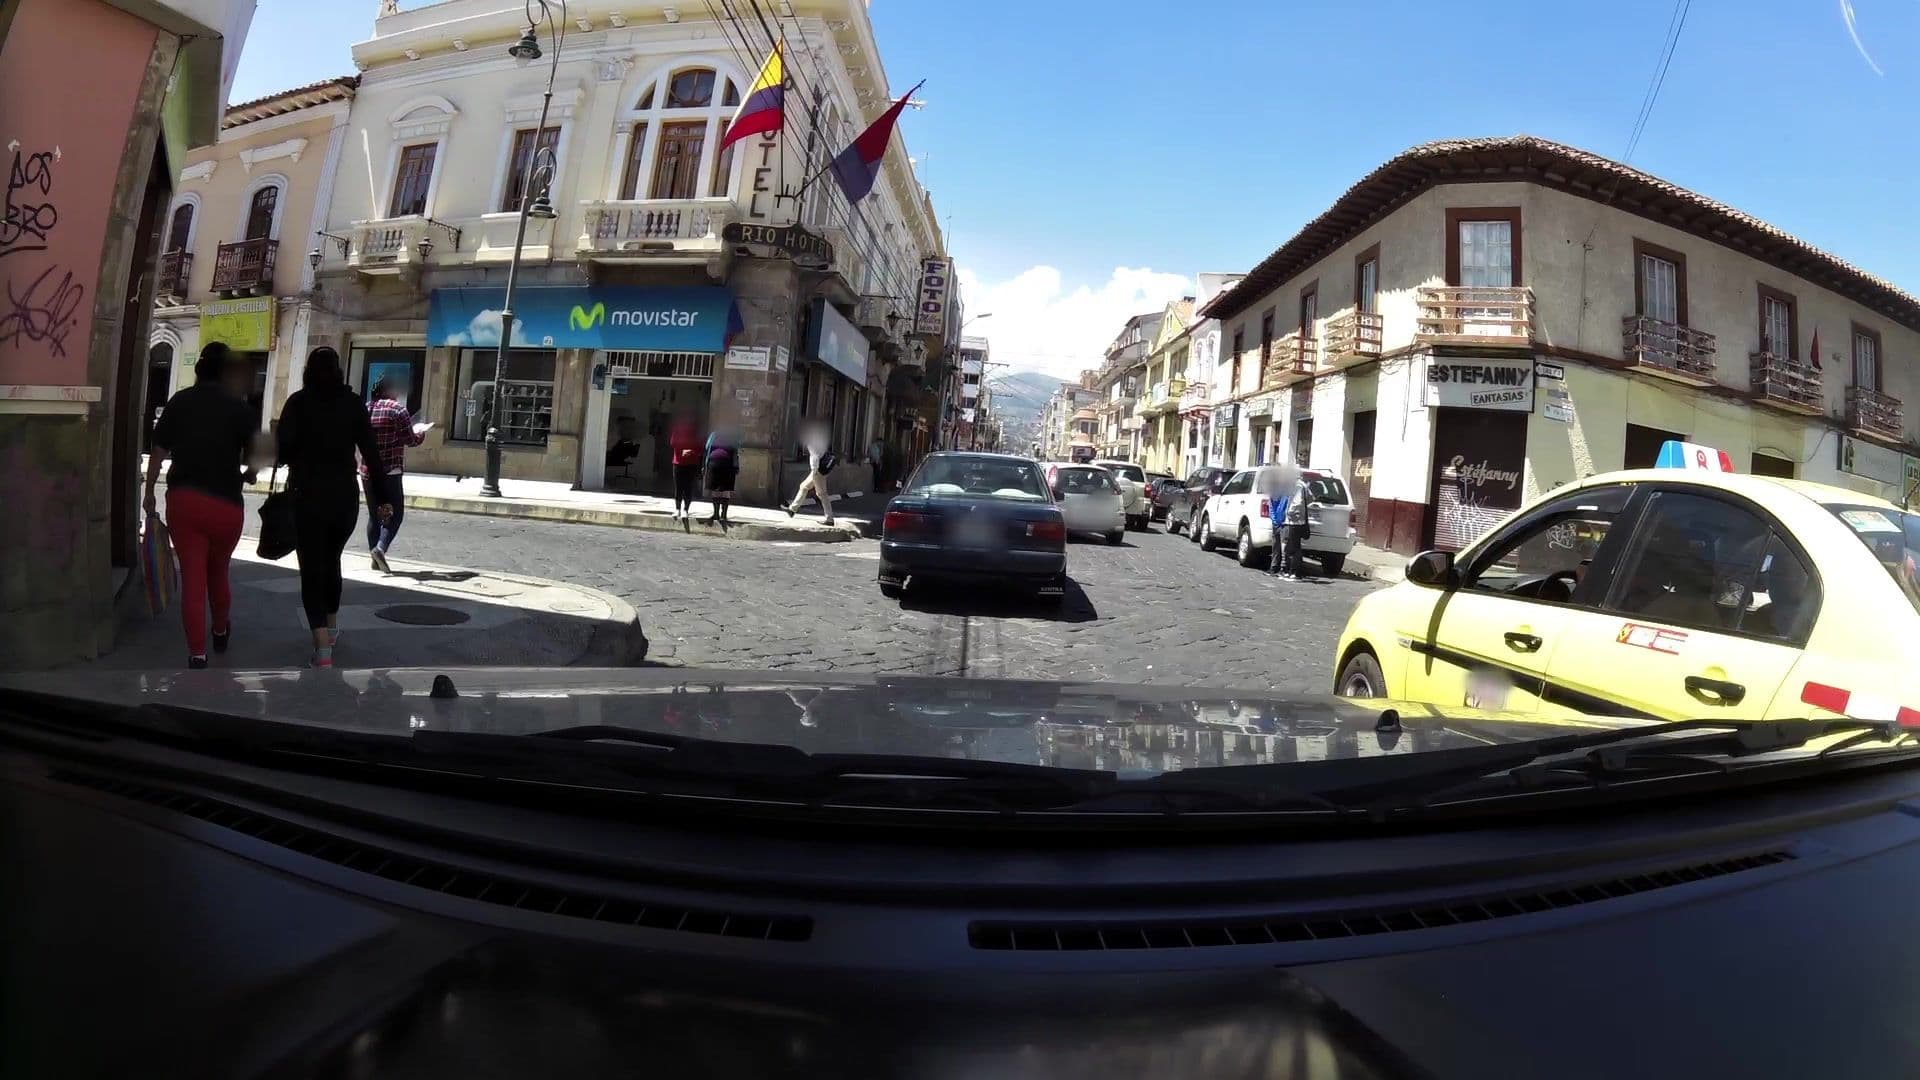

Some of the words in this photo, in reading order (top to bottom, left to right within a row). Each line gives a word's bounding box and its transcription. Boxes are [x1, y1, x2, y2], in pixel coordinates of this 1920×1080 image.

[749, 129, 777, 218] OTEL
[741, 225, 777, 244] RIO
[922, 262, 946, 313] FOTO
[611, 308, 699, 327] movistar
[1427, 364, 1531, 387] ESTEFANNY
